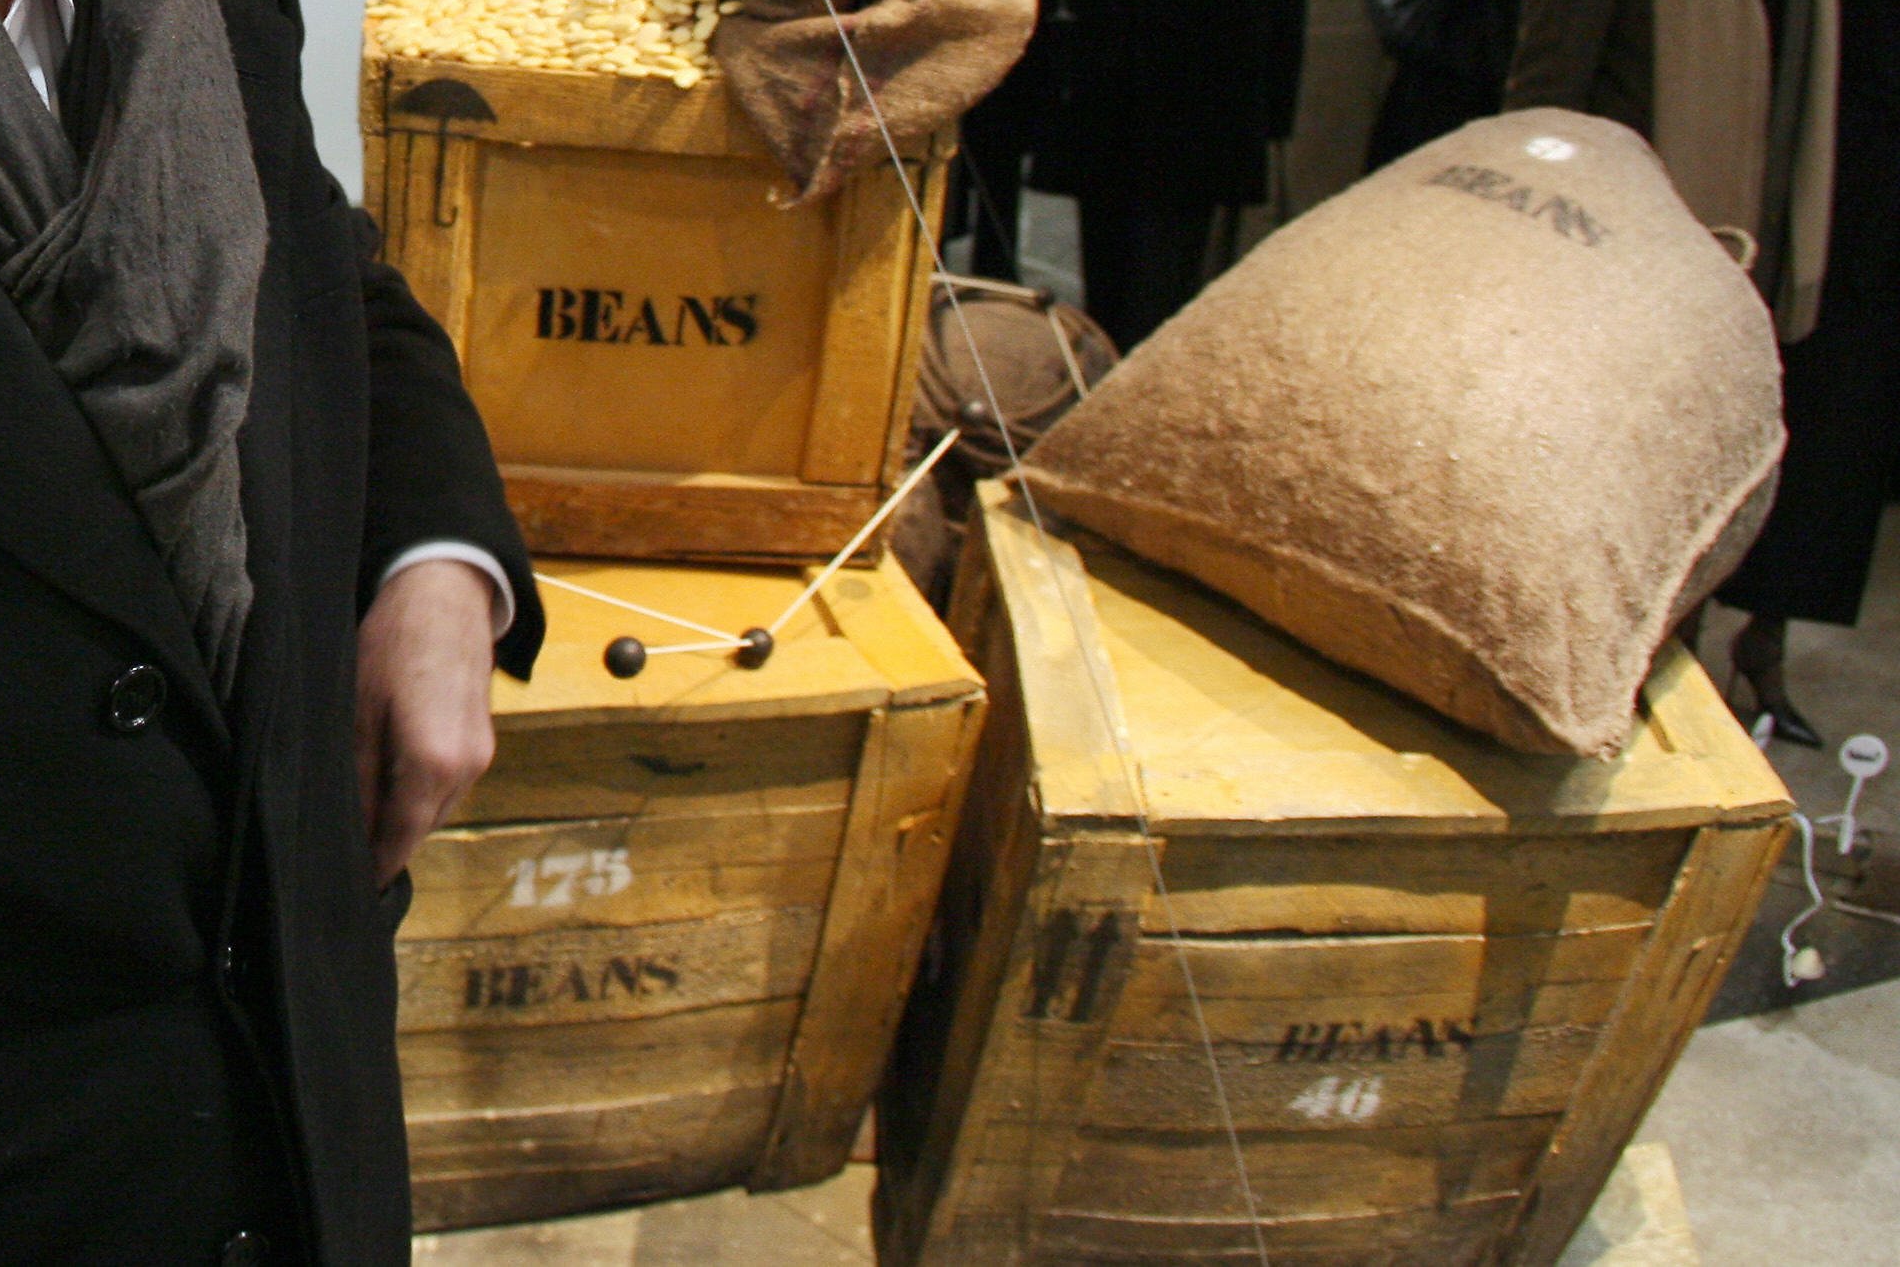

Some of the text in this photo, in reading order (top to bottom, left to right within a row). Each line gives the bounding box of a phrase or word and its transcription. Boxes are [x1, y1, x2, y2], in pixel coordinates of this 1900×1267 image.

[1428, 164, 1612, 247] BEANS
[534, 287, 758, 346] BEANS
[505, 848, 634, 908] 175
[464, 955, 683, 1010] BEANS
